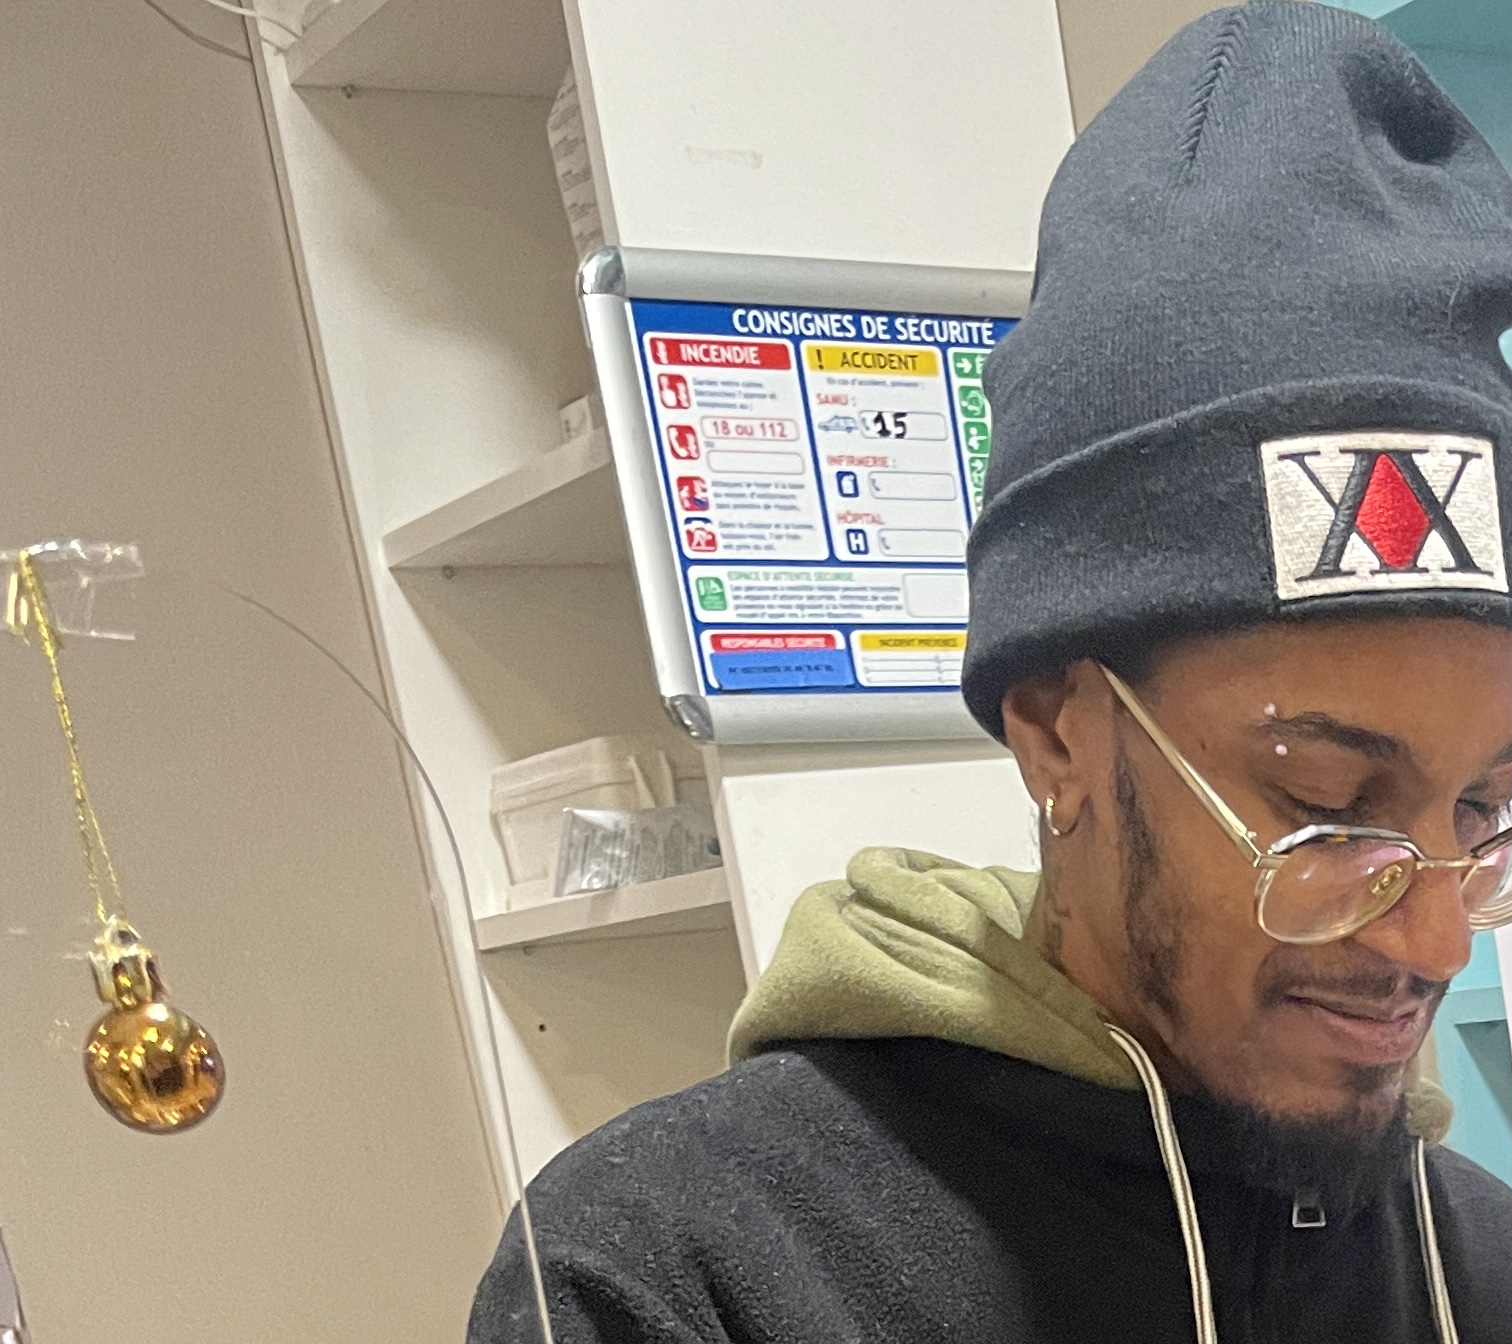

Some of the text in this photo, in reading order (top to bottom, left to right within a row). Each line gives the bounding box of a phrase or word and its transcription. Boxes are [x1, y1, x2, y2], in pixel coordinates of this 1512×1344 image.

[732, 308, 857, 339] CONSIGNES
[861, 316, 891, 341] DE
[679, 342, 761, 366] INCENDIE
[839, 351, 918, 372] ACCIDENT
[712, 420, 729, 436] 18
[760, 422, 788, 438] 112
[873, 411, 908, 439] 15
